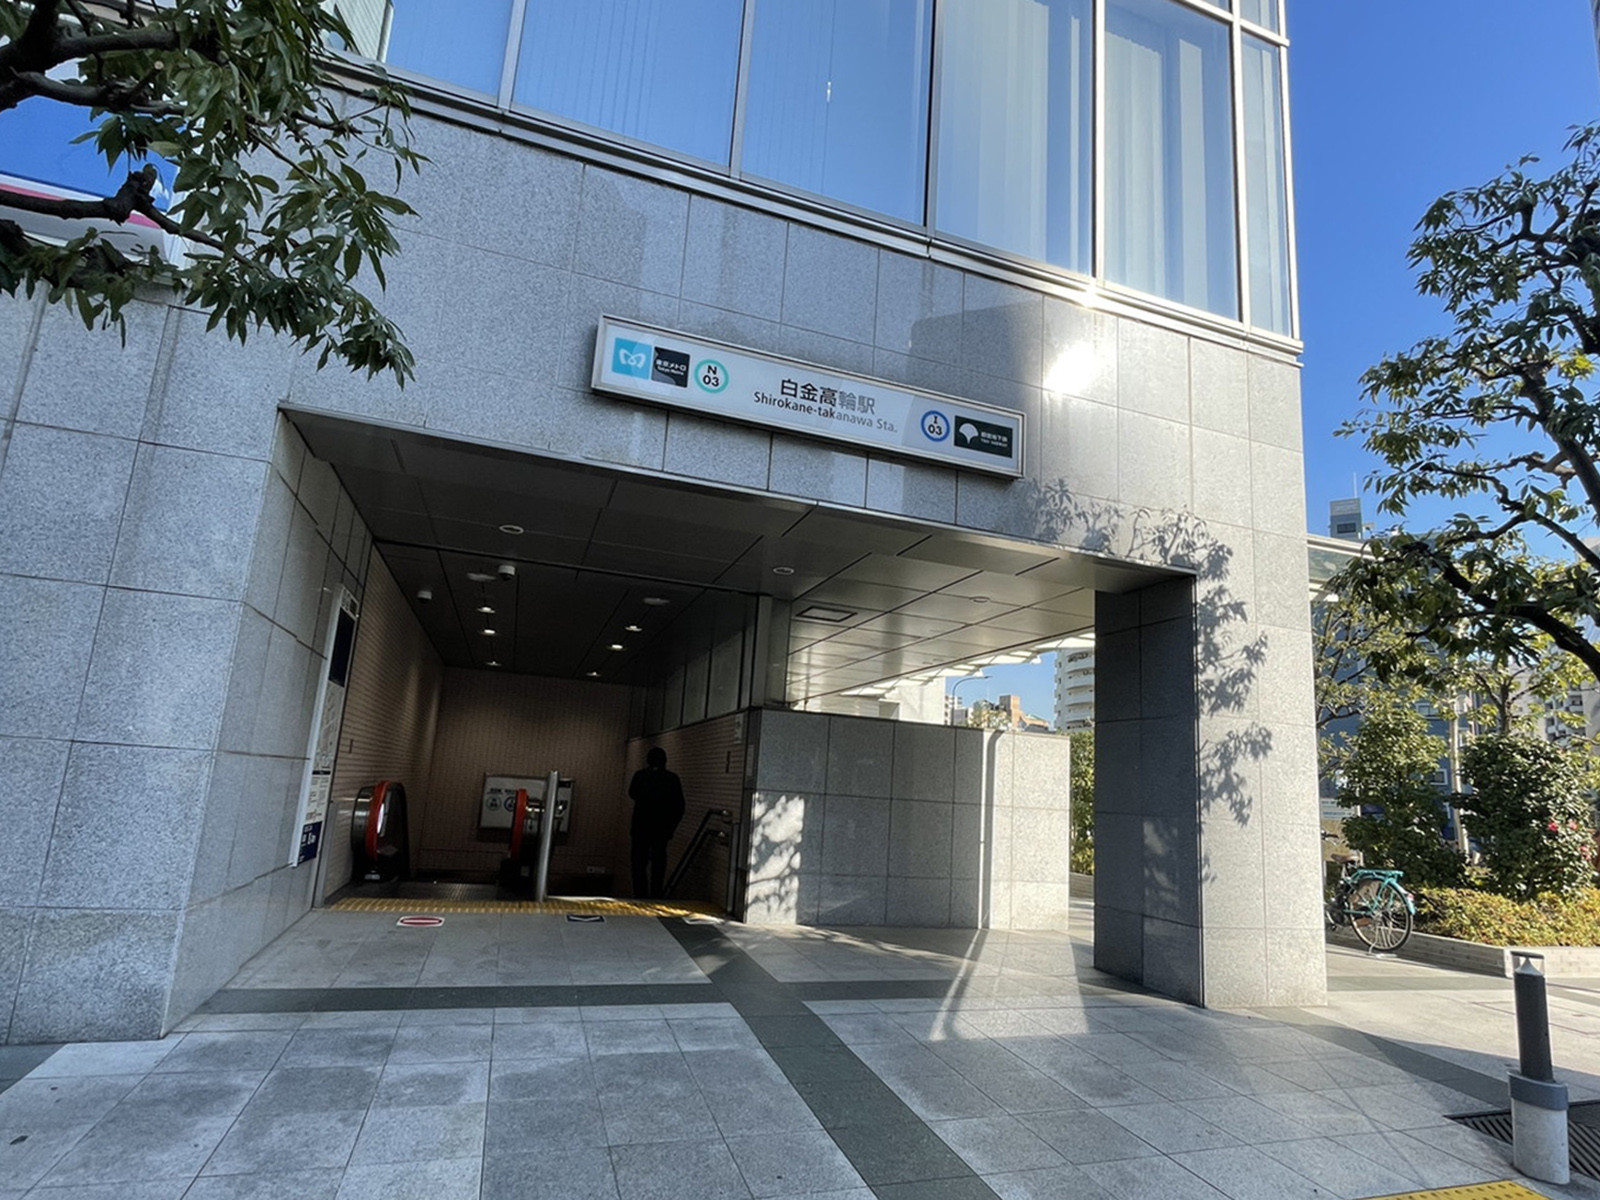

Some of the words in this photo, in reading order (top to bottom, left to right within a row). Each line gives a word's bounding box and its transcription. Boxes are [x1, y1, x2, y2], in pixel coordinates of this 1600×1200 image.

[707, 365, 717, 375] N
[702, 375, 720, 387] 03
[780, 378, 876, 415] 白金高輪駅
[754, 391, 874, 428] Shirokane-takanawa
[876, 418, 898, 433] Sta.
[928, 424, 943, 436] 03
